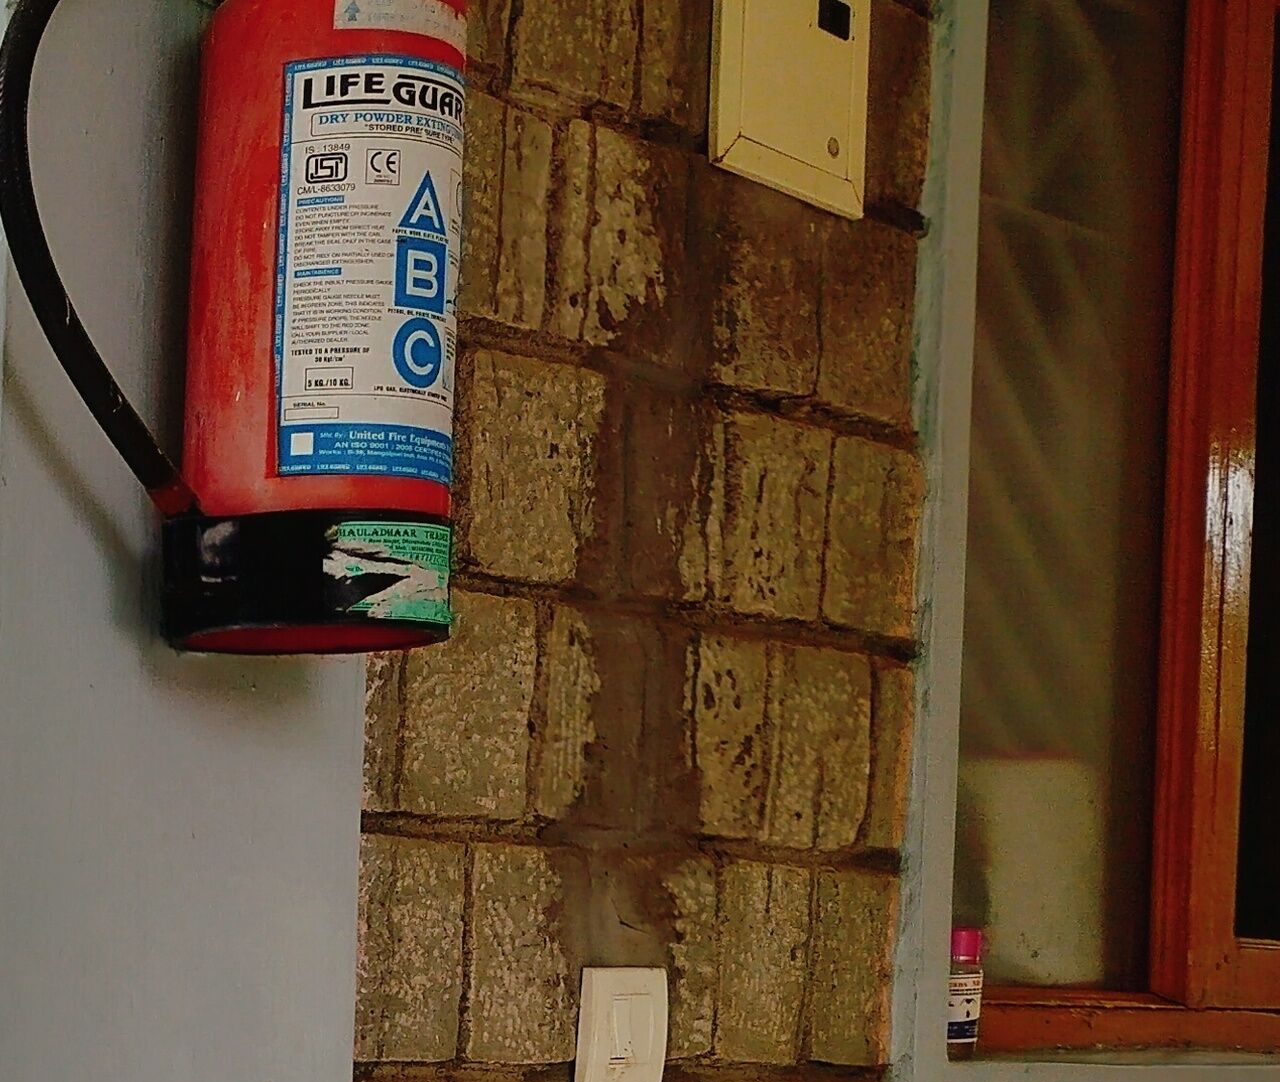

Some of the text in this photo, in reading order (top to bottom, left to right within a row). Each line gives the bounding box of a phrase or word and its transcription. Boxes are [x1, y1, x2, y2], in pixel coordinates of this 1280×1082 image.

[303, 73, 391, 109] LIFE
[319, 112, 349, 125] DRY
[354, 112, 412, 124] POWDER
[305, 146, 314, 154] IS
[323, 143, 350, 152] 13849
[370, 152, 397, 174] CE
[409, 187, 440, 229] A
[406, 250, 438, 298] B
[404, 330, 434, 376] C
[349, 430, 385, 440] United
[389, 432, 406, 442] Fire
